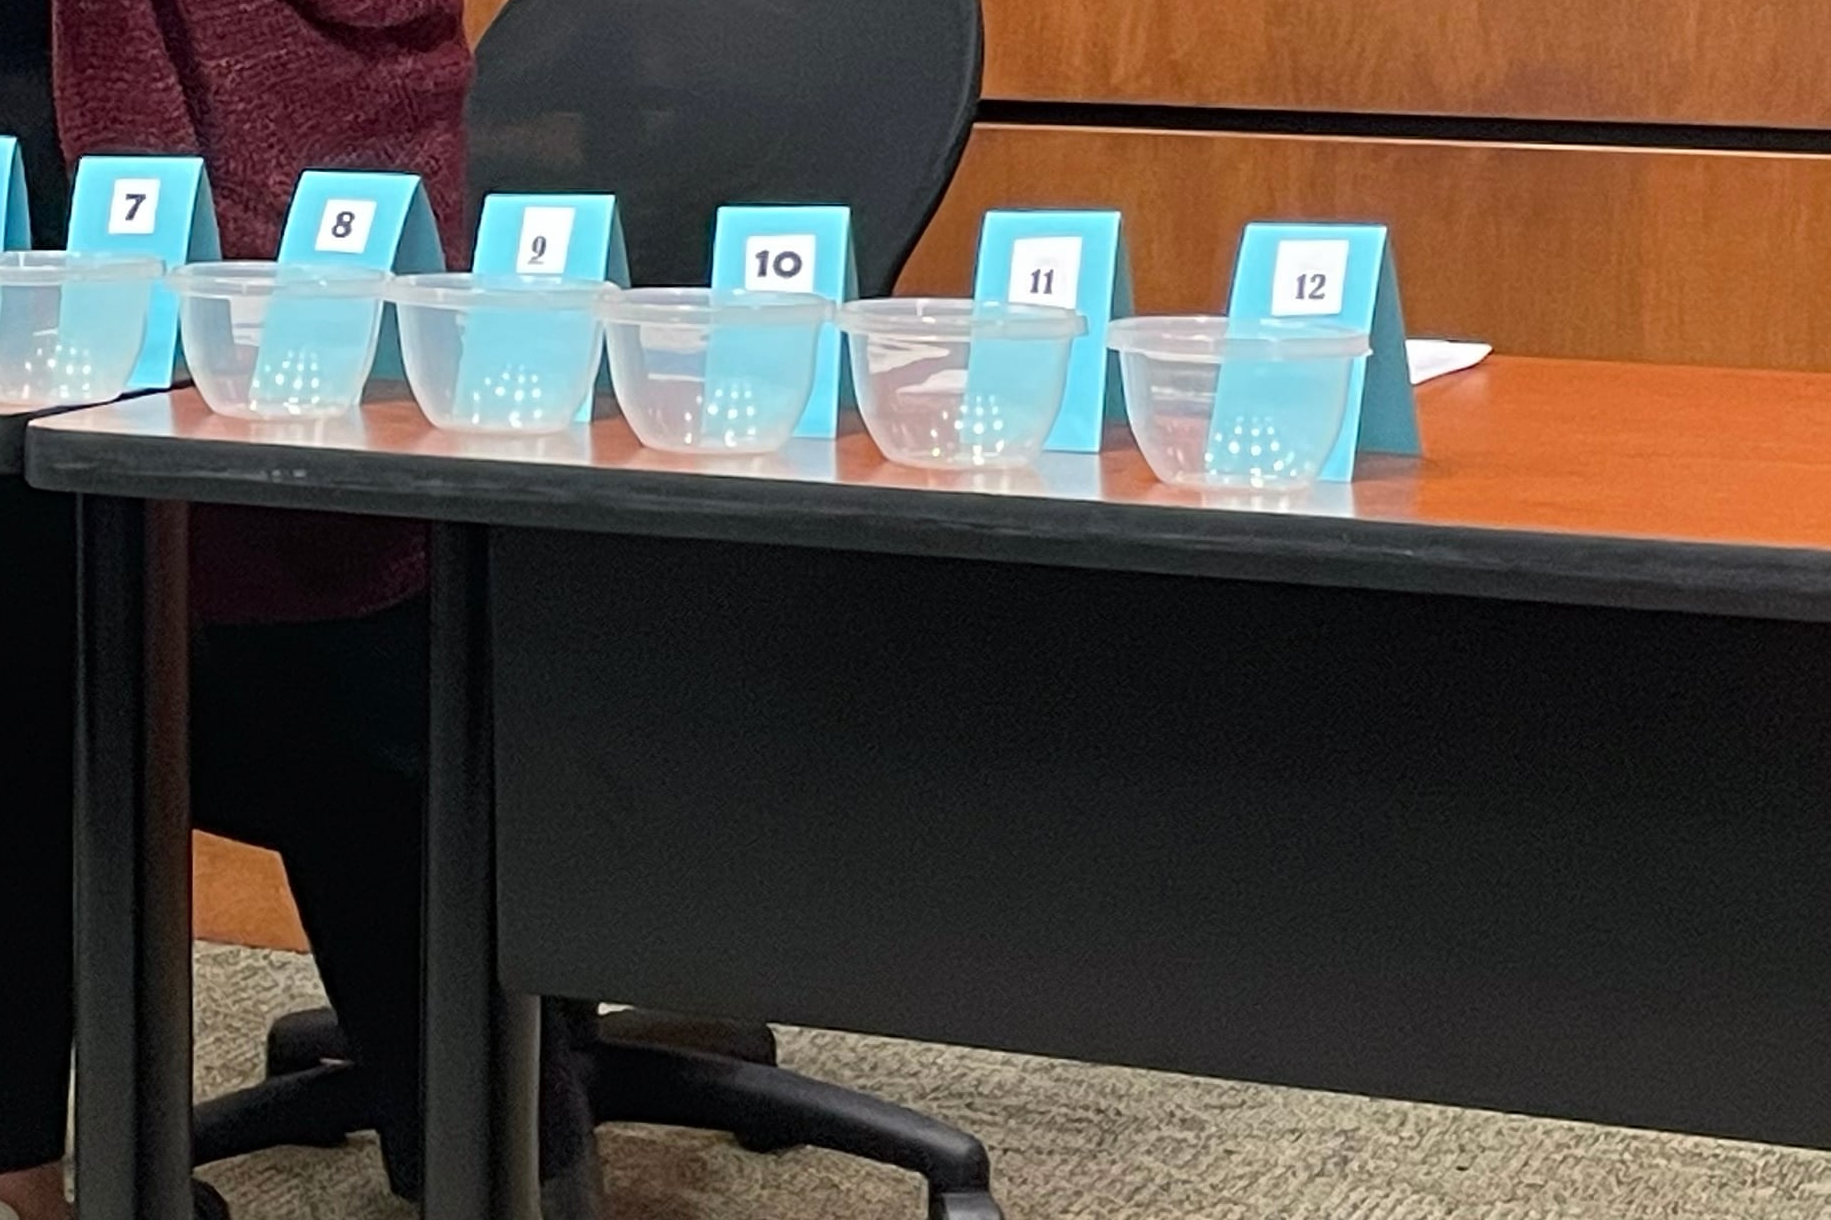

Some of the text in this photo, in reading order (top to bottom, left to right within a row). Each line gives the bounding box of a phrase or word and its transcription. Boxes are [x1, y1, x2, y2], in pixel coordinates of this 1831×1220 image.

[125, 193, 147, 221] 7
[331, 211, 355, 238] 8
[531, 236, 547, 259] 9
[755, 250, 803, 278] 10
[1029, 269, 1054, 294] 11
[1295, 274, 1326, 300] 12
